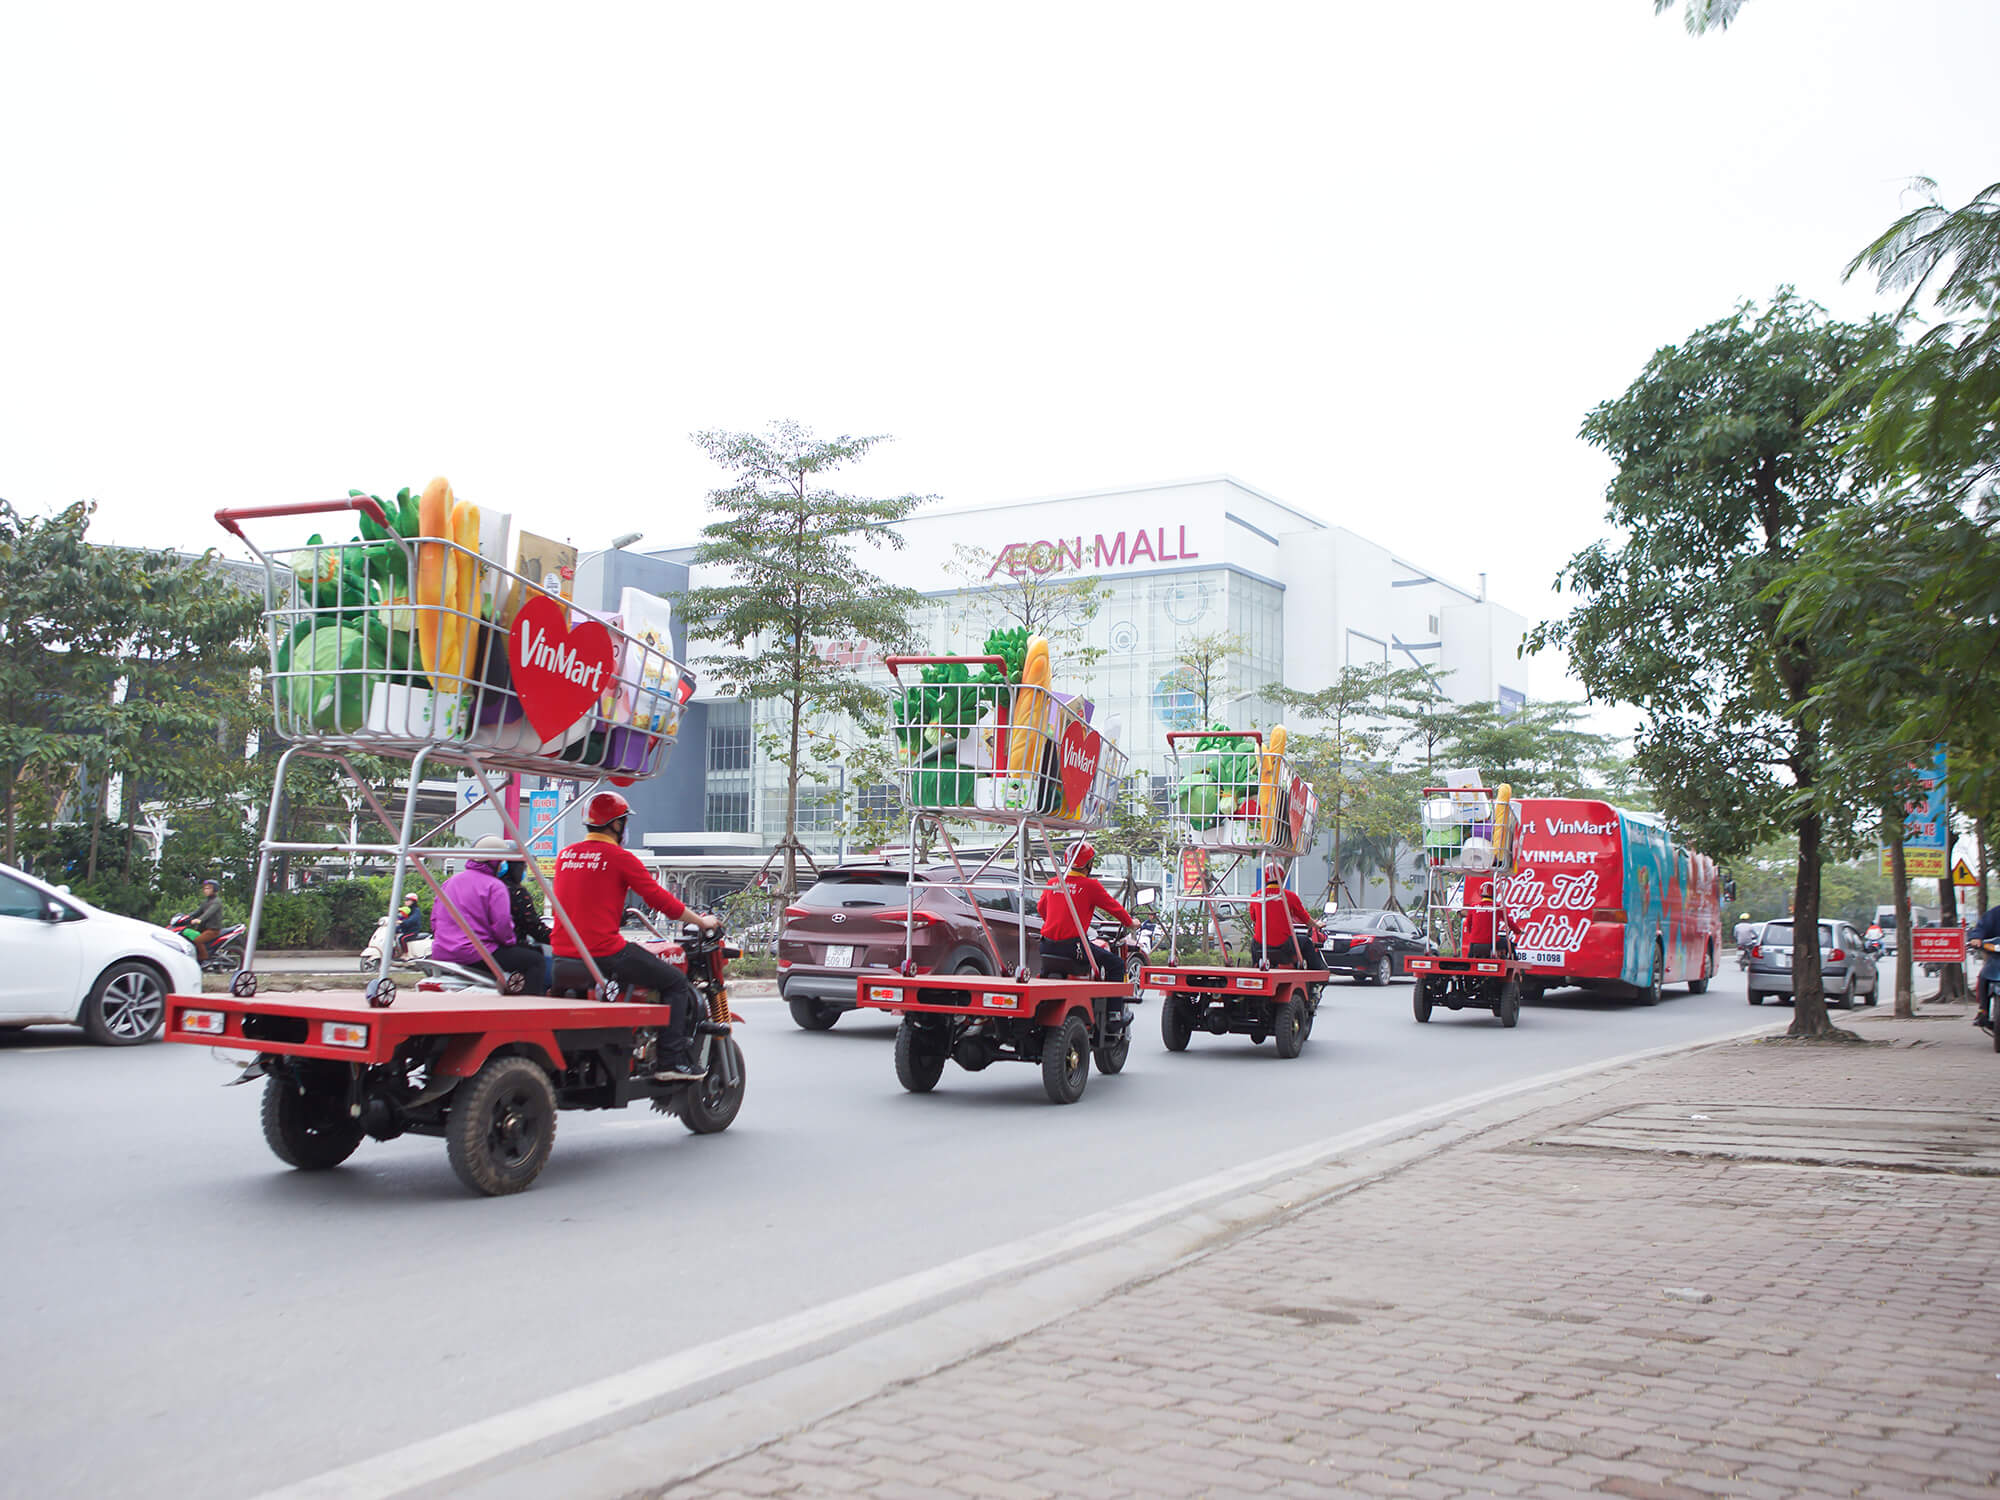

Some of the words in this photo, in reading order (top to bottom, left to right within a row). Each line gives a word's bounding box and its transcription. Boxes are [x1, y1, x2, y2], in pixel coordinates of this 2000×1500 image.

[1094, 525, 1199, 567] MALL
[521, 619, 602, 692] VinMart
[1063, 737, 1096, 776] VinMart
[1522, 850, 1598, 864] VINMART
[1547, 870, 1599, 910] Tết
[1517, 914, 1591, 952] nhà!
[1536, 952, 1561, 963] 01098
